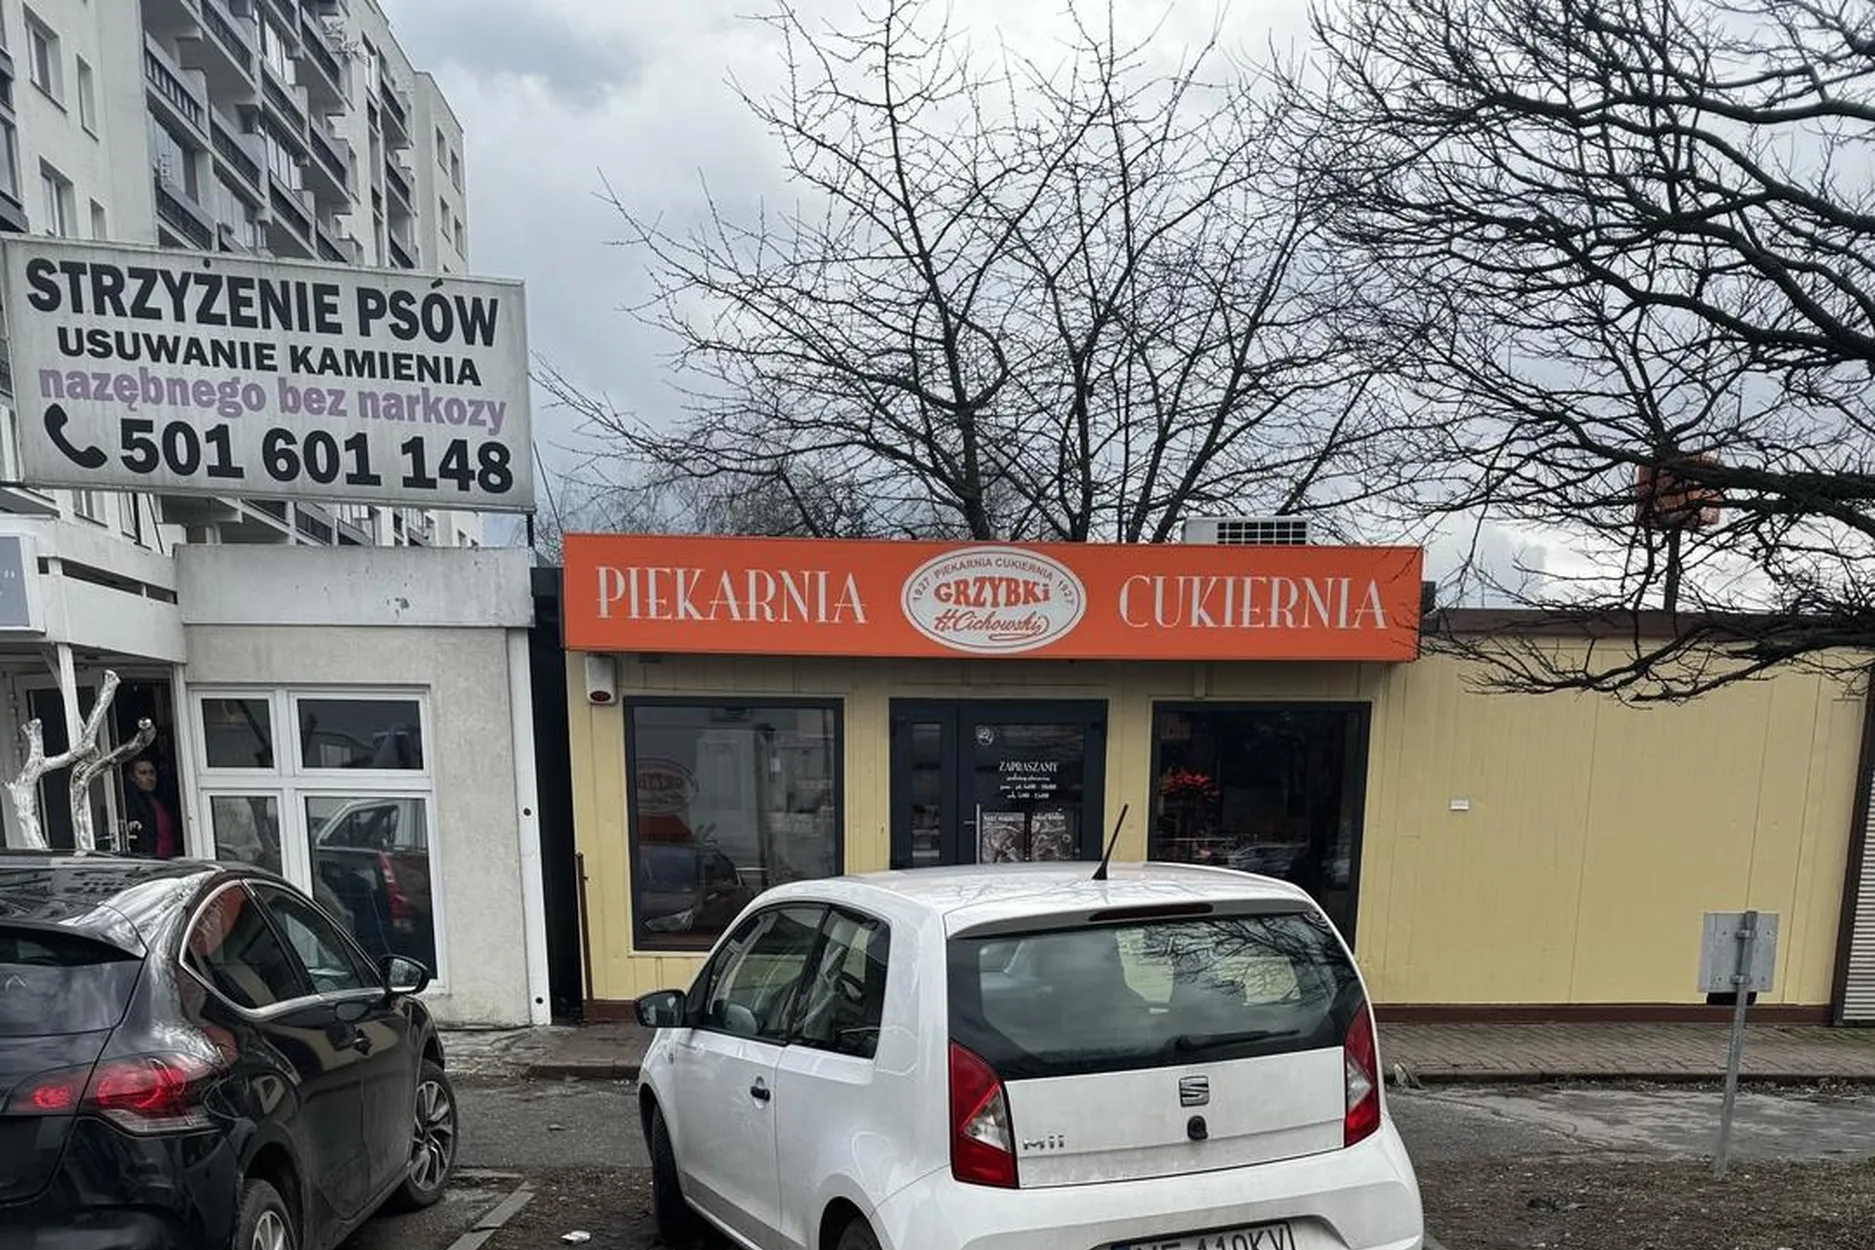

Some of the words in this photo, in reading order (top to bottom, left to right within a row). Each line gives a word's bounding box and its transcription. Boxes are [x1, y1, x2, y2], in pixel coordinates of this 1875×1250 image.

[26, 258, 342, 335] STRZYŻENIE
[356, 278, 499, 347] PSÓW
[58, 327, 278, 372] USUWANIE
[290, 346, 482, 387] KAMIENIA
[38, 367, 267, 418] nazębnego
[278, 379, 348, 418] bez
[358, 386, 507, 436] narkozy
[120, 418, 244, 479] 501
[262, 427, 382, 488] 601
[401, 435, 513, 494] 148
[595, 565, 868, 625] PIEKARNIA
[913, 577, 930, 601] 1927
[933, 558, 993, 579] PIEKARNIA
[995, 558, 1053, 581] CUKIERNIA
[1119, 574, 1390, 630] CUKIERNIA
